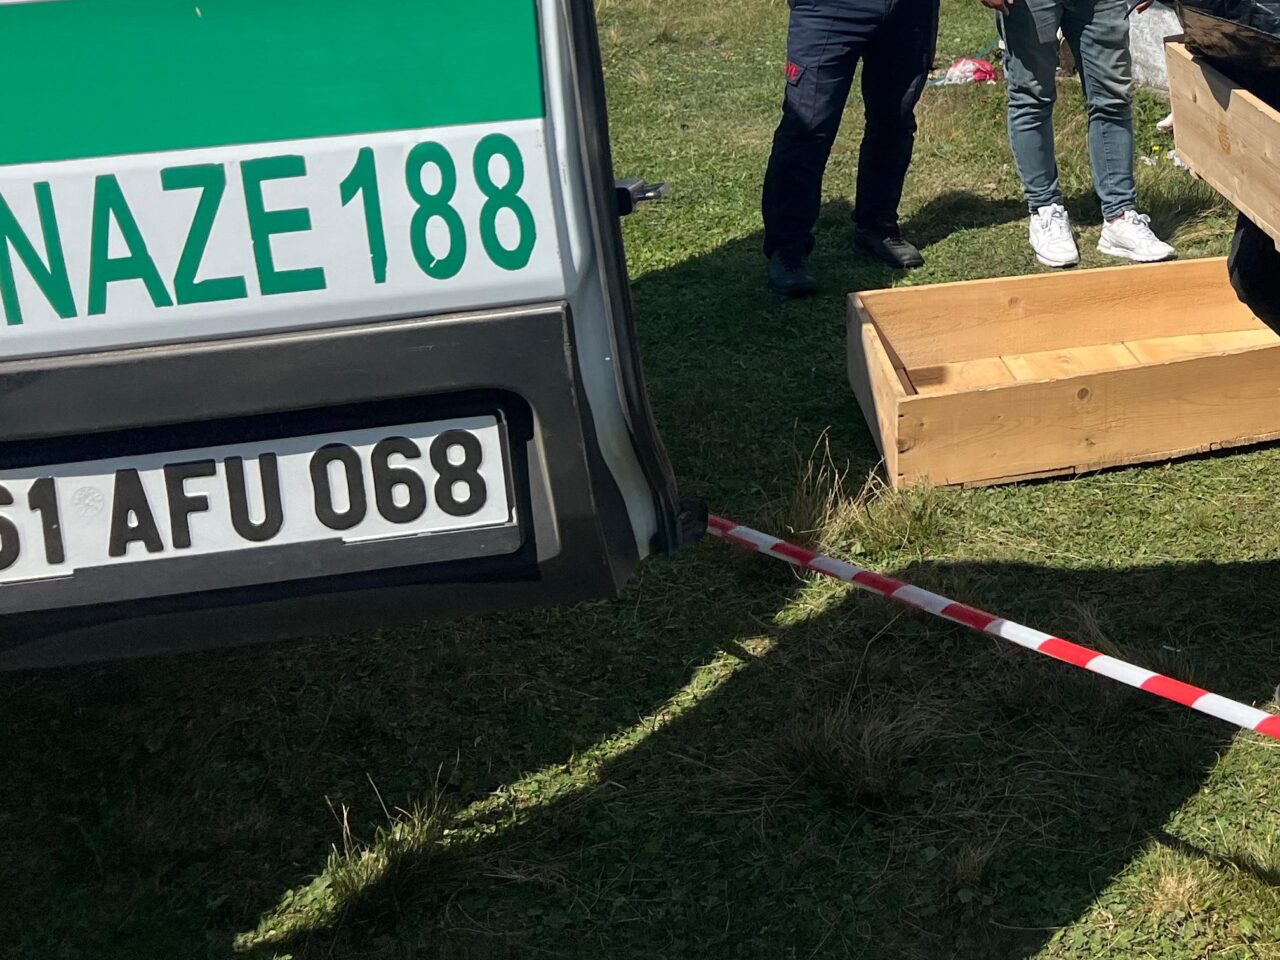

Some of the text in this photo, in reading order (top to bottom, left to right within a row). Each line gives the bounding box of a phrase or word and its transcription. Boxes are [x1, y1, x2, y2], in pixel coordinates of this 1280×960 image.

[339, 133, 537, 284] 188
[107, 451, 286, 558] AFU
[309, 428, 488, 532] 068
